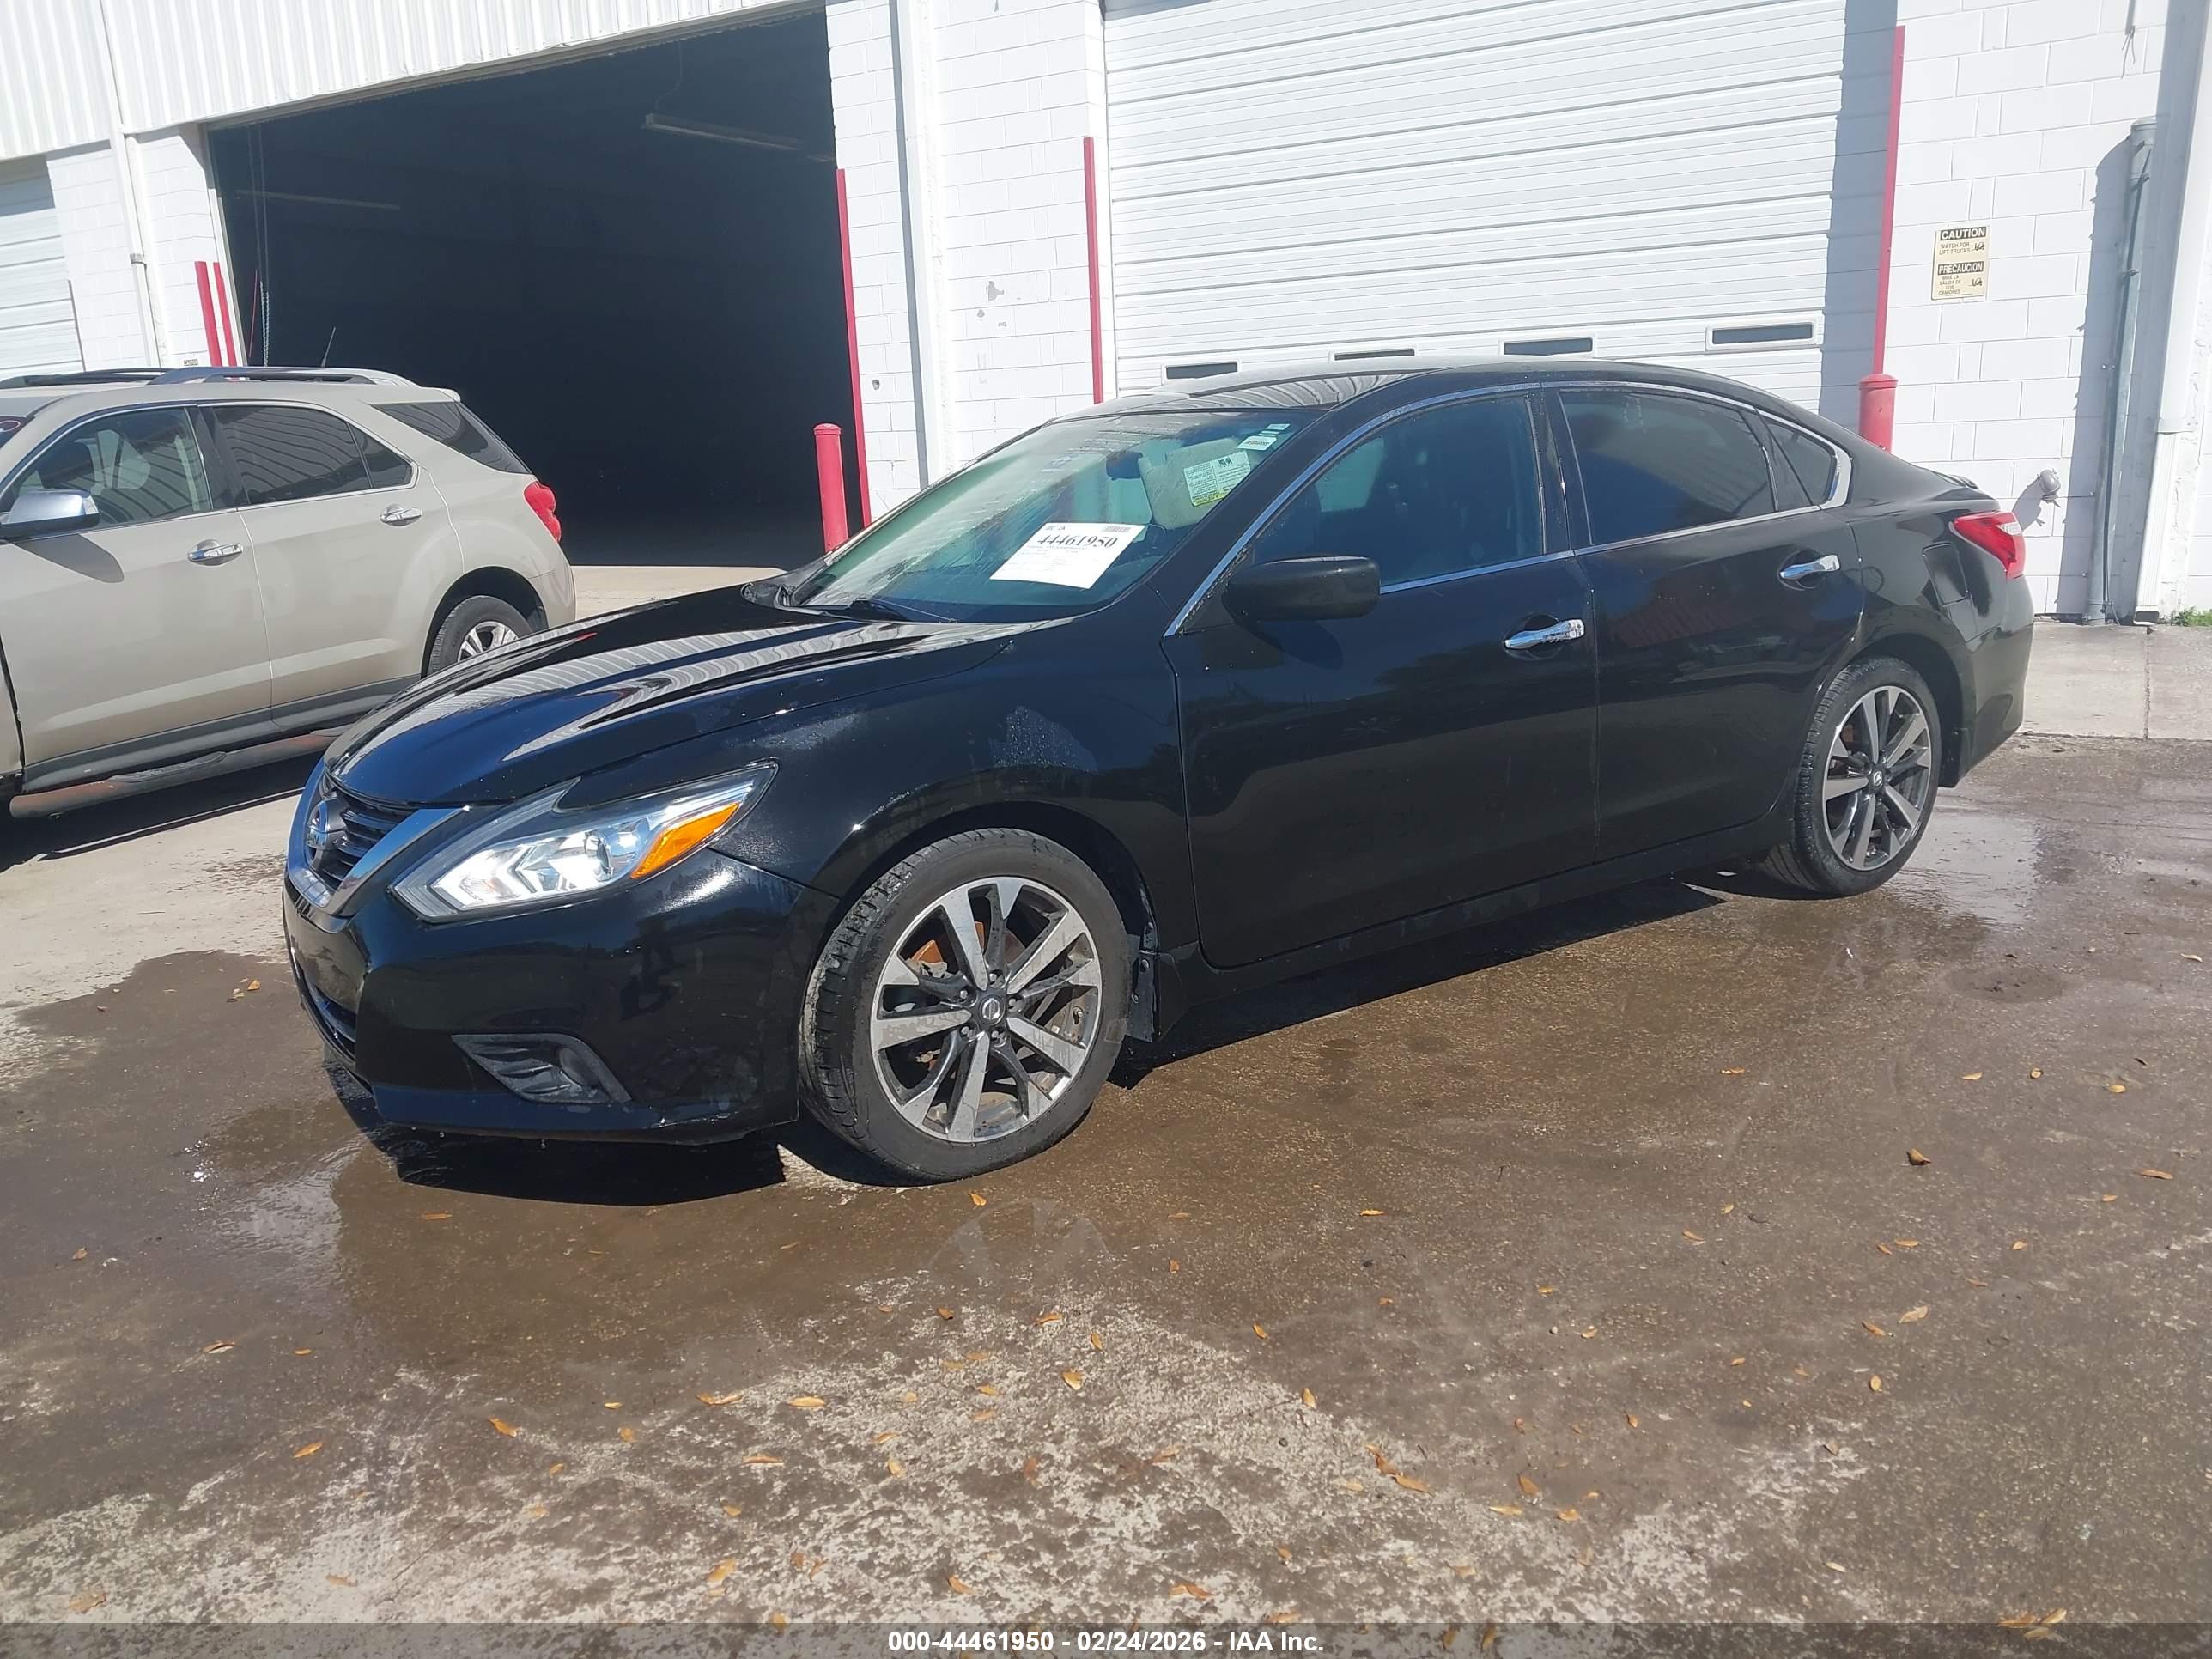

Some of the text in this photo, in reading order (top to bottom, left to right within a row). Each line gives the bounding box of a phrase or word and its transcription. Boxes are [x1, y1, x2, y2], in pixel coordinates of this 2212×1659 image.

[1942, 228, 1985, 240] CAUTION
[1939, 262, 1983, 275] PRECAUCION
[1037, 534, 1118, 548] 44461950
